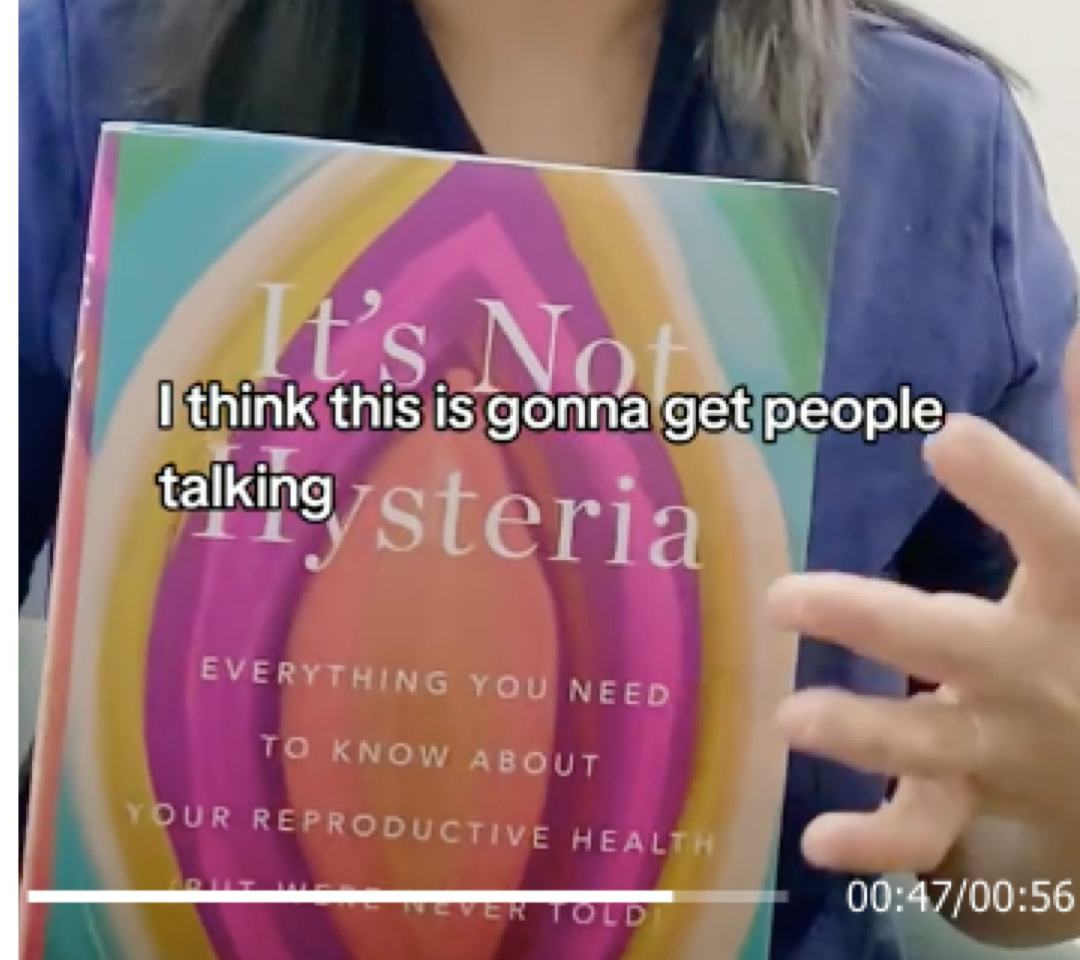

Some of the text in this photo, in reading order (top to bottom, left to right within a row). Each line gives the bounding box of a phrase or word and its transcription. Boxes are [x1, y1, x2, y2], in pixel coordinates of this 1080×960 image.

[254, 282, 690, 400] It's Not
[190, 443, 704, 572] Hysteria
[200, 656, 671, 708] EVERYTHING YOU NEED
[261, 734, 600, 778] TO KNOW ABOUT
[125, 802, 714, 856] YOUR REPRODUCTIVE HEALTH
